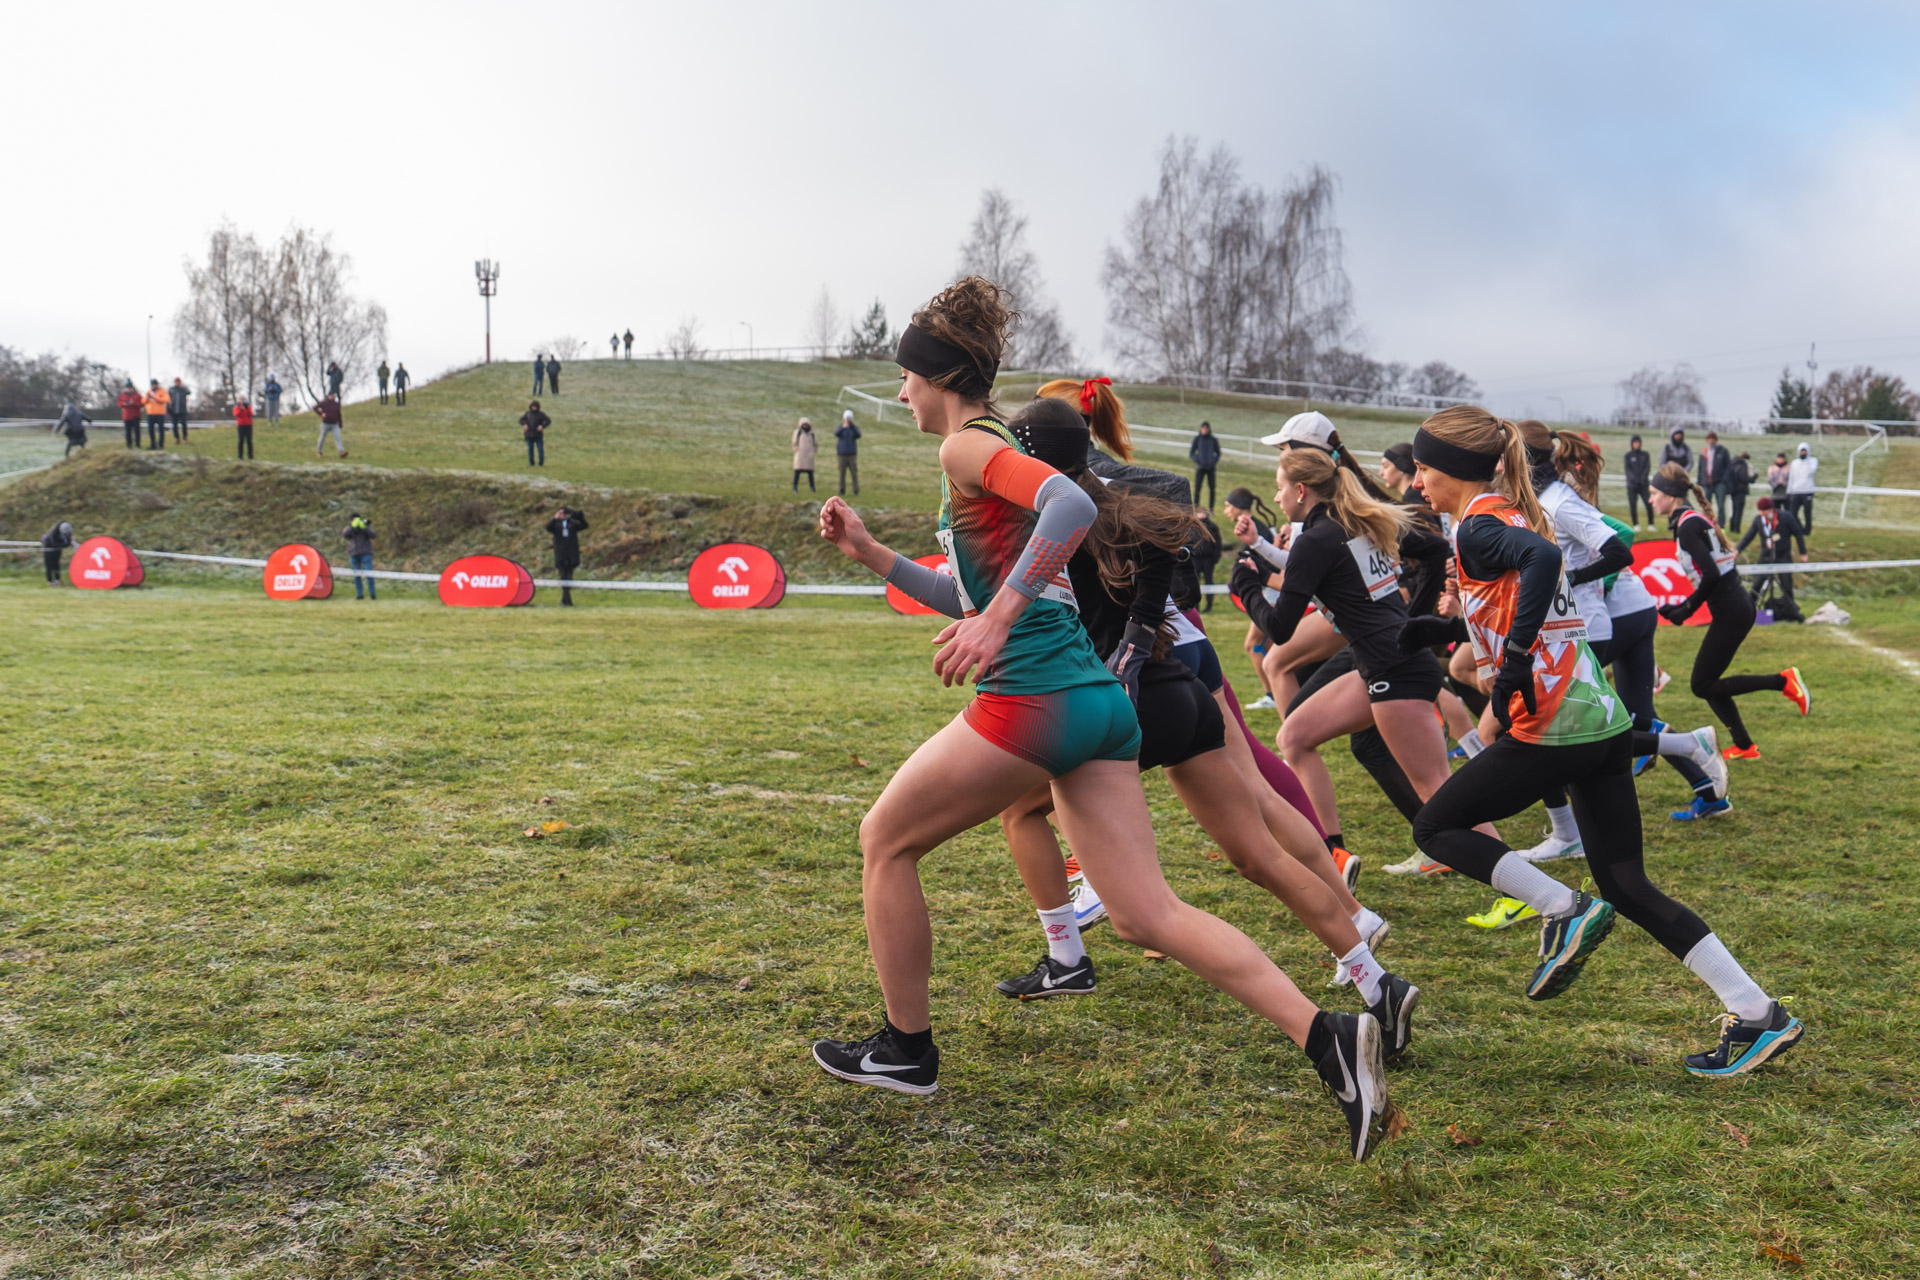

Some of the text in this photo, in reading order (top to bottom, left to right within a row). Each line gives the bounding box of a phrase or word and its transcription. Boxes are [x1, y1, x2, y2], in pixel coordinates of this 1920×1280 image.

[470, 575, 508, 588] ORLEN
[712, 584, 750, 598] ORLEN
[1554, 581, 1581, 617] 64
